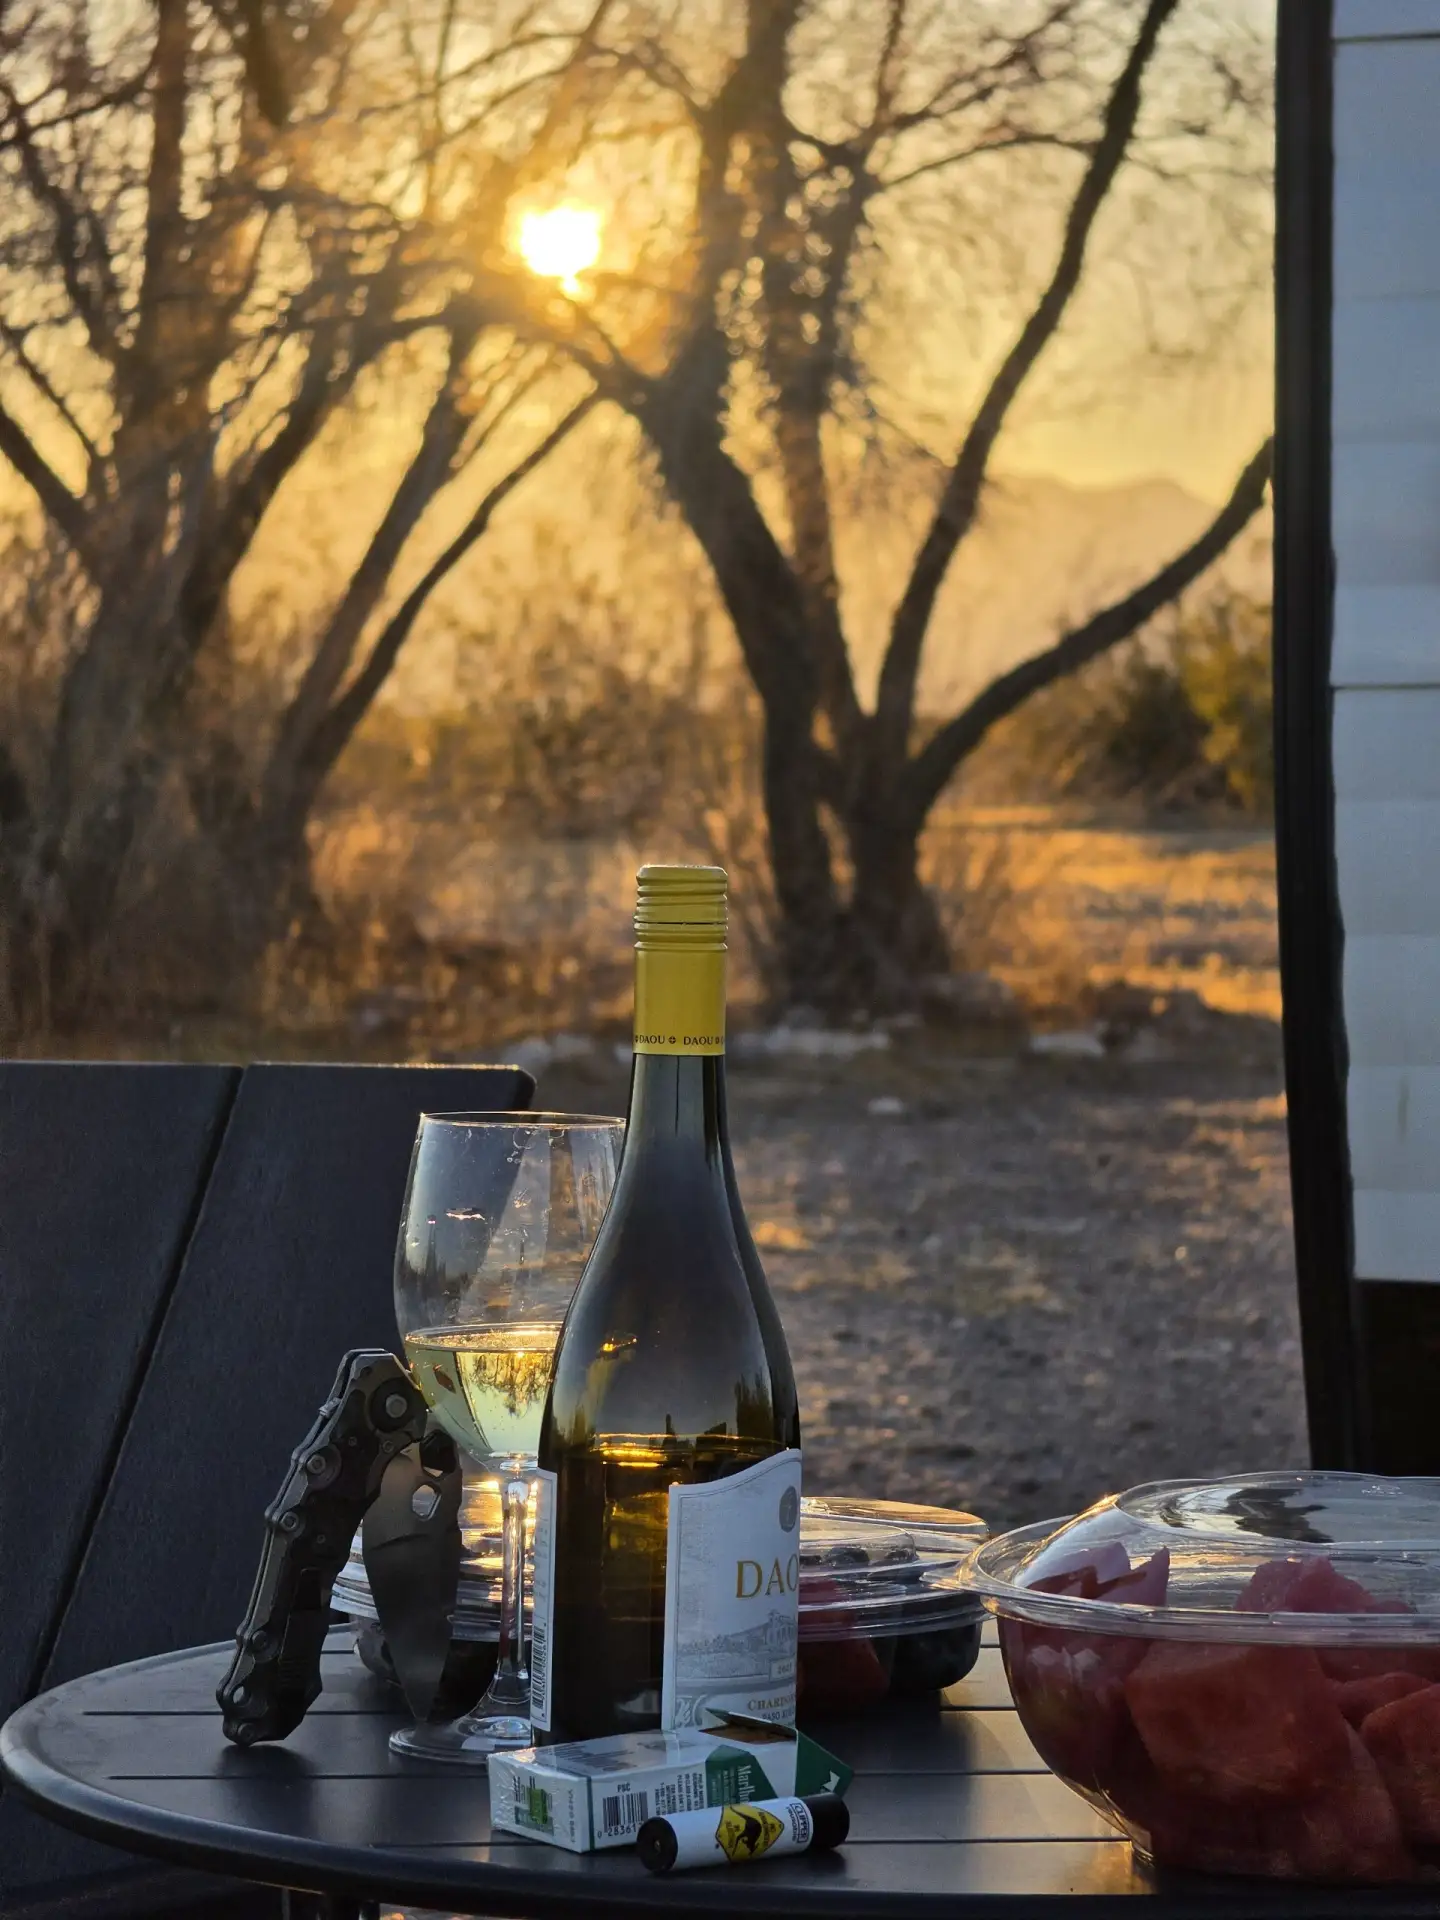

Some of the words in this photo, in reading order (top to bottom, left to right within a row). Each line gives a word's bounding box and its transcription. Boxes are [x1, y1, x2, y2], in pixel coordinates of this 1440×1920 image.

[640, 1035, 666, 1044] DAOU
[683, 1036, 713, 1045] DAOU
[736, 1554, 799, 1598] DAO
